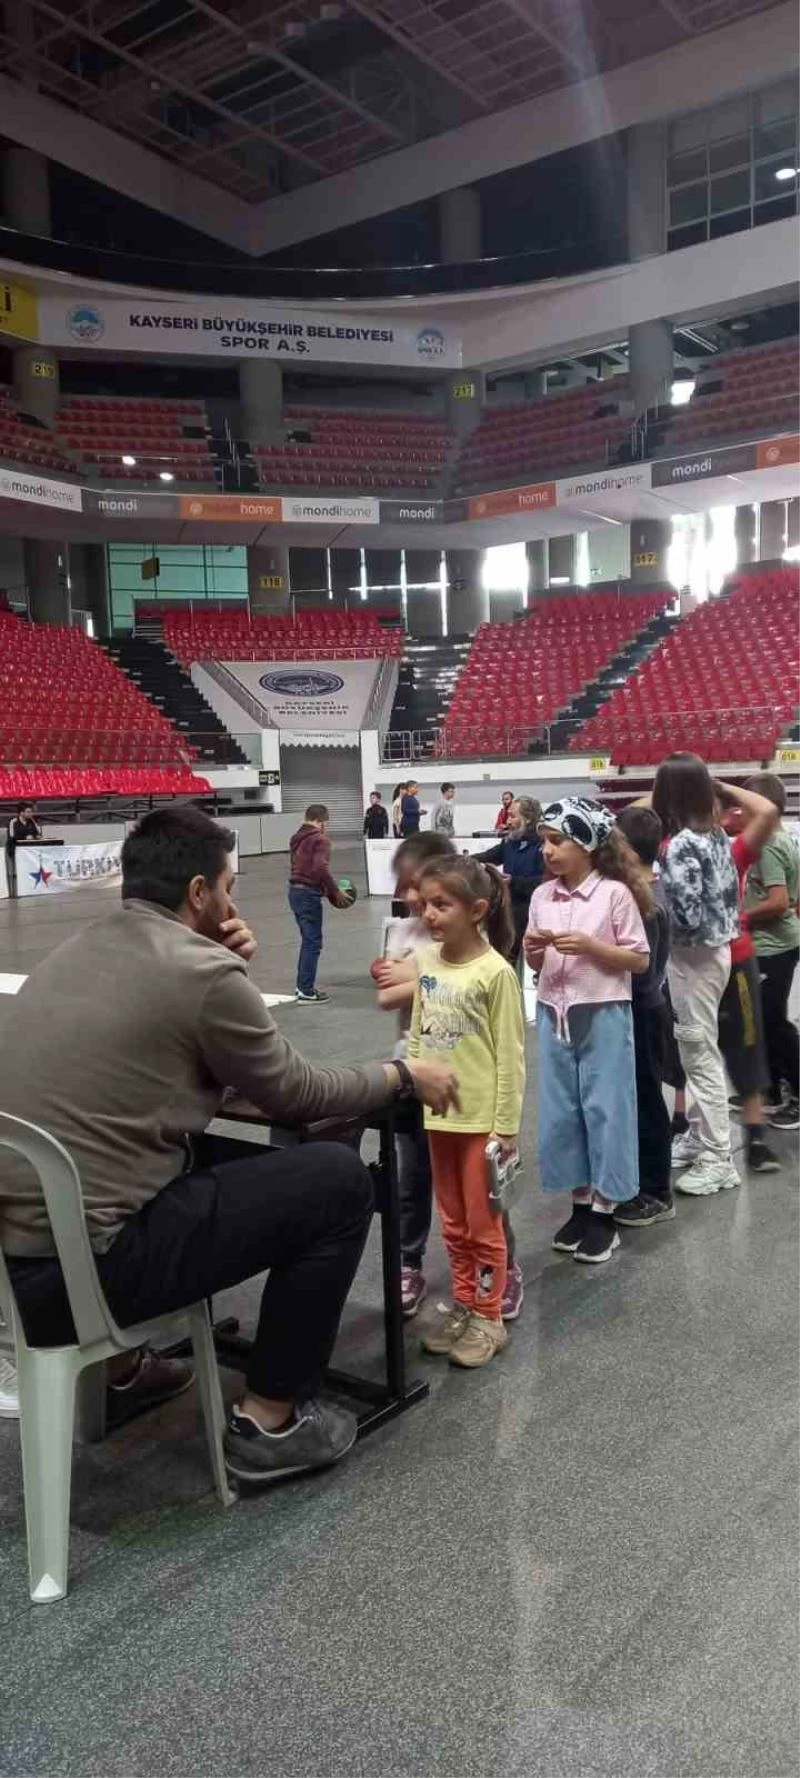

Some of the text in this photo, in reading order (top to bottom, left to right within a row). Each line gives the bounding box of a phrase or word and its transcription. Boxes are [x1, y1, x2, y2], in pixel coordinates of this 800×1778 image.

[202, 317, 303, 336] BÜYÜKŞEHİR
[307, 325, 394, 342] BELEDİYESİ
[220, 336, 310, 354] SPOR A.Ş.
[672, 458, 712, 477] mondi
[98, 499, 137, 510] mondi
[518, 491, 548, 506] home
[240, 503, 274, 515] home
[400, 507, 435, 518] mondi
